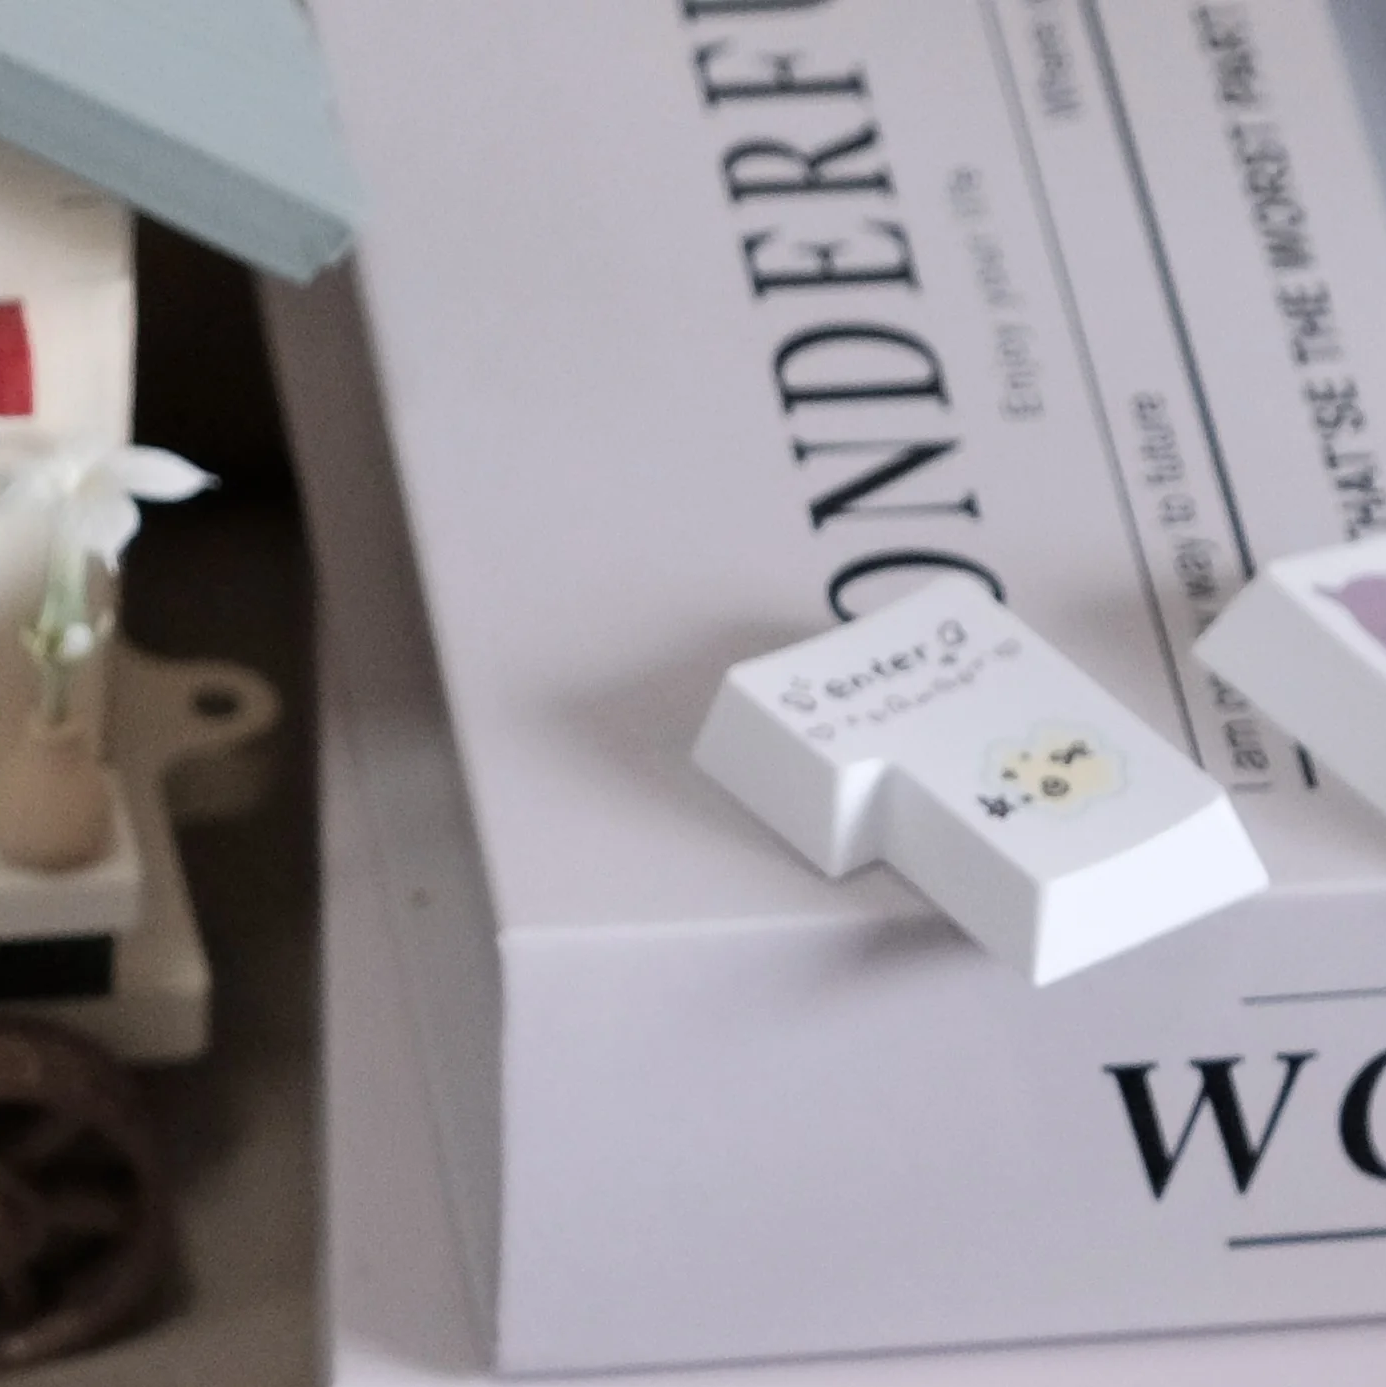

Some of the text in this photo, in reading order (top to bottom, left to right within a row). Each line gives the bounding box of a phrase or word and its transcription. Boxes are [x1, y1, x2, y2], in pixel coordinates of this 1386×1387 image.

[675, 0, 1006, 626] ONDERF
[1275, 280, 1344, 368] THE
[1131, 390, 1185, 485] future
[824, 643, 927, 700] enter
